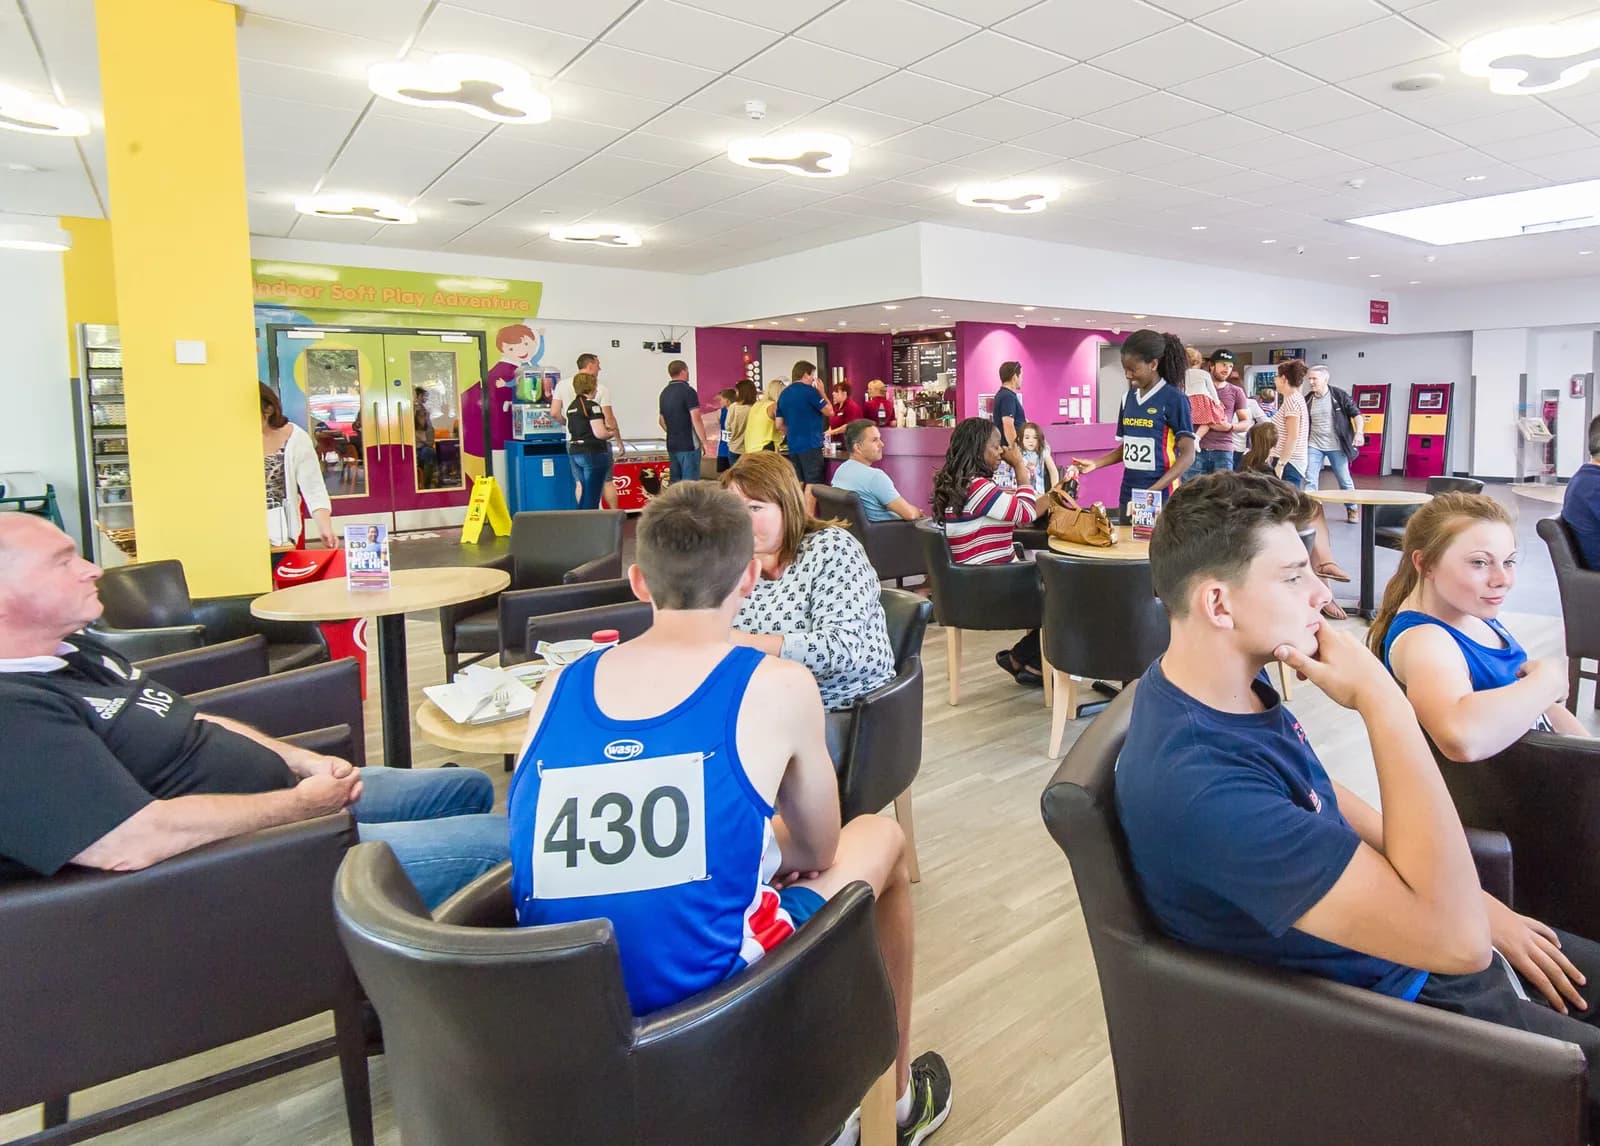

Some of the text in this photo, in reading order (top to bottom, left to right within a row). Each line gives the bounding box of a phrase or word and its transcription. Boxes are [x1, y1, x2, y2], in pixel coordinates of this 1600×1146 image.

[253, 278, 531, 311] Indoor Soft Play Adventure
[1125, 443, 1151, 463] 232
[607, 743, 641, 758] wasp
[543, 786, 690, 868] 430
